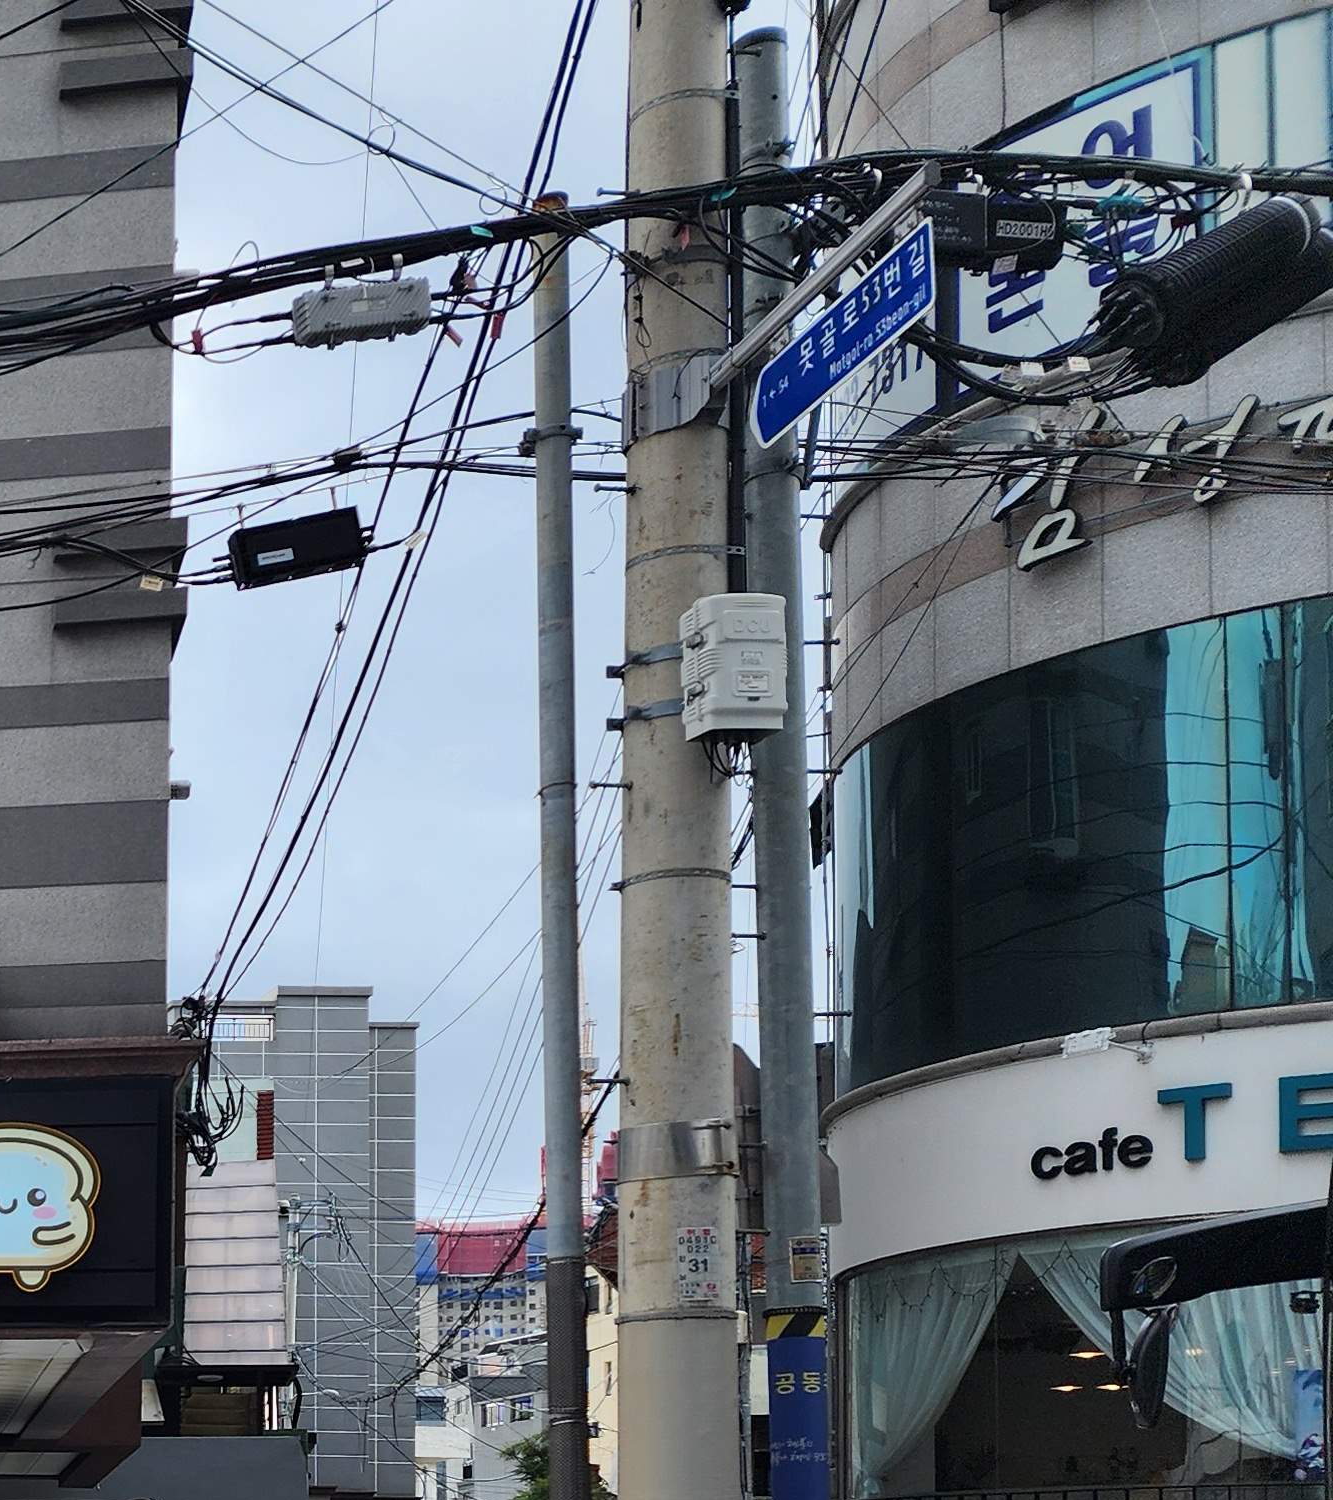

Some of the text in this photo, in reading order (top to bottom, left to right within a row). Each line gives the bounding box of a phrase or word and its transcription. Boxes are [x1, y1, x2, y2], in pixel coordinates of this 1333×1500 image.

[798, 234, 926, 378] 못골로53번길
[1031, 1127, 1153, 1180] cafe
[688, 1258, 708, 1273] 31
[774, 1372, 828, 1395] 공동
